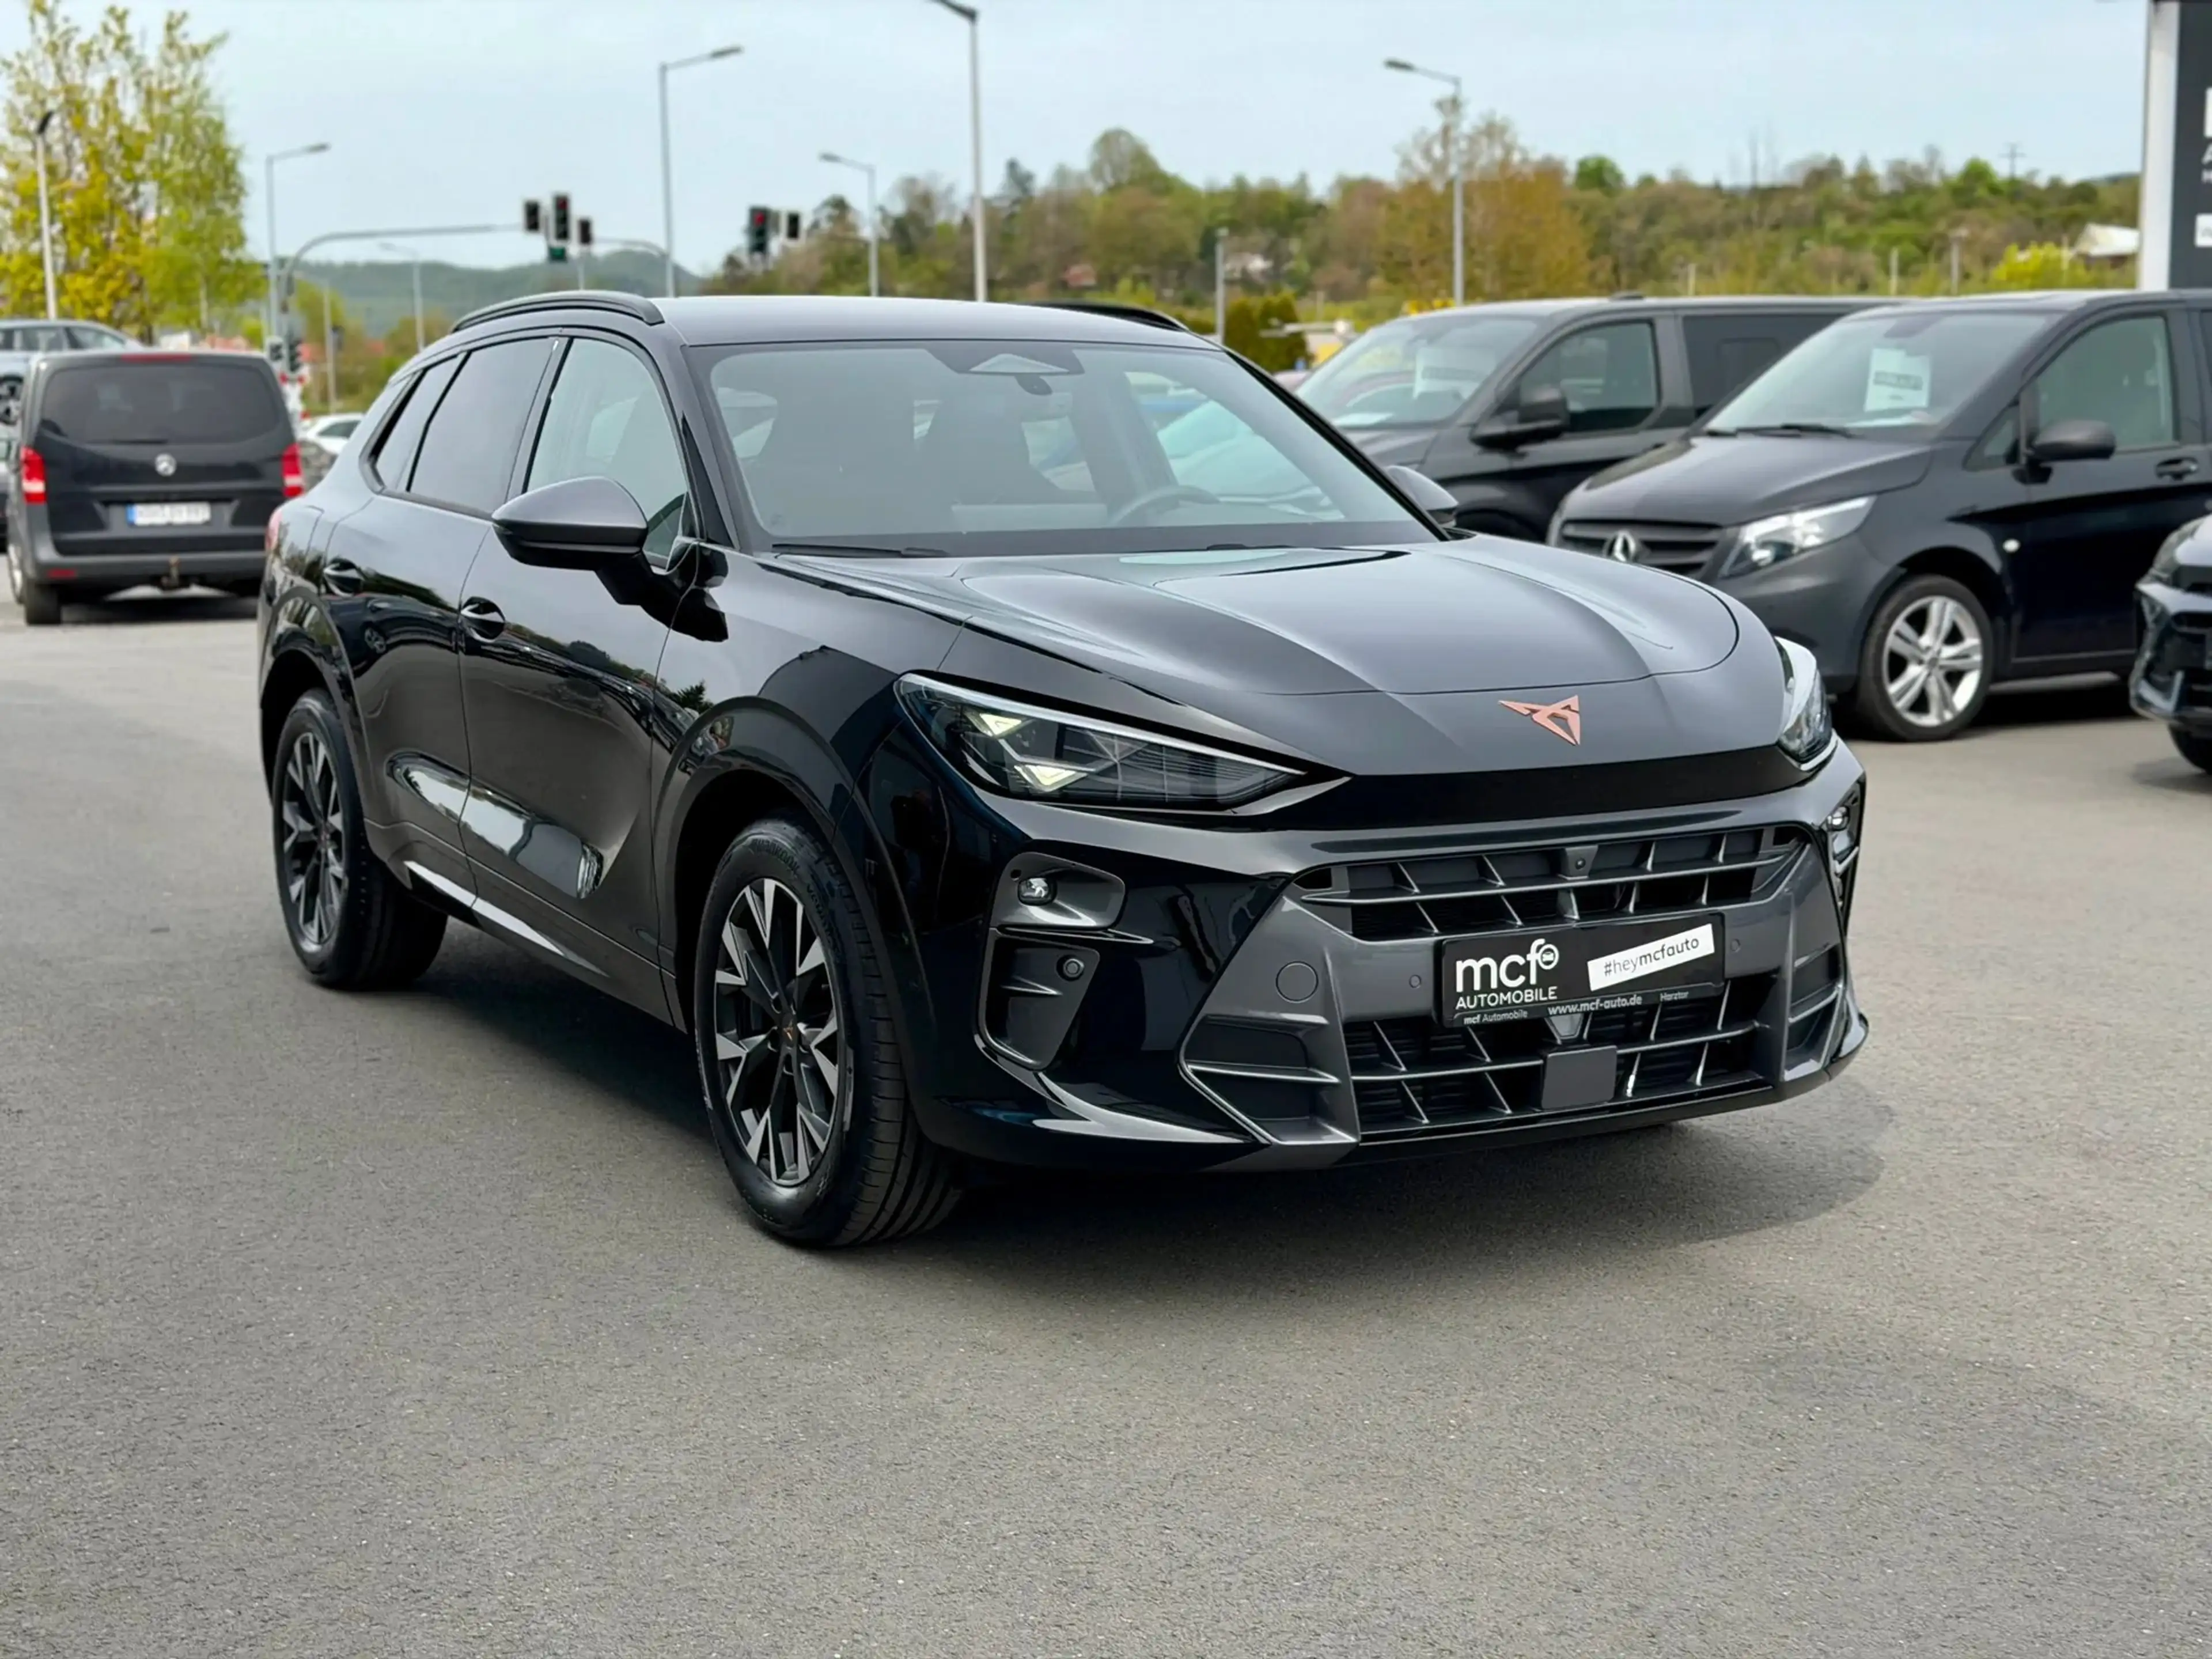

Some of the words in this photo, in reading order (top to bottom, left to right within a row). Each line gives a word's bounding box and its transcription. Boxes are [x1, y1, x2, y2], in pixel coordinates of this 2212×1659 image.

[1604, 938, 1699, 977] #heymcfauto
[1455, 986, 1558, 1010] AUTOMOBILE
[1548, 994, 1643, 1015] www.mcf-auto.de
[1464, 1015, 1481, 1025] mcf
[1482, 1010, 1528, 1023] Automobile
